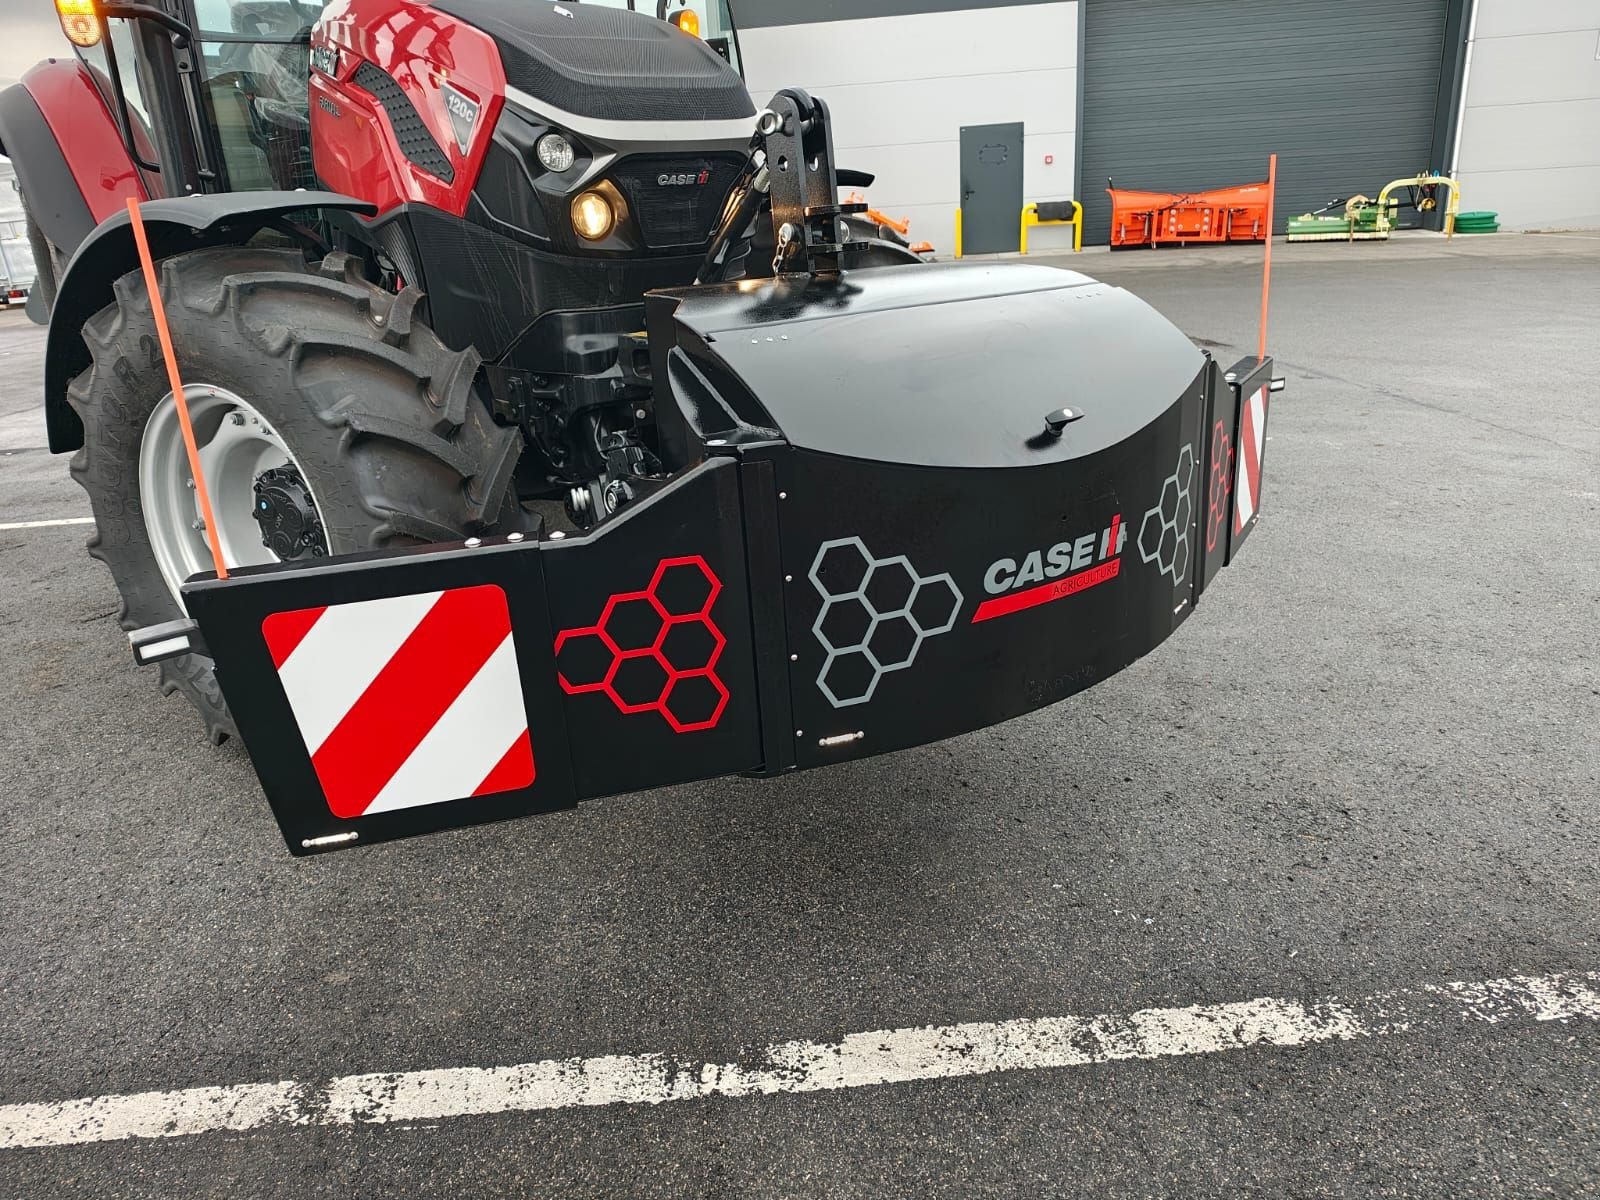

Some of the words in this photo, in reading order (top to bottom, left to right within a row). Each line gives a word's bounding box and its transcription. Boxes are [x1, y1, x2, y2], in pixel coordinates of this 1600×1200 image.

[657, 174, 697, 186] CASE
[983, 532, 1096, 594] CASE
[1053, 562, 1117, 596] AGRICULTURE
